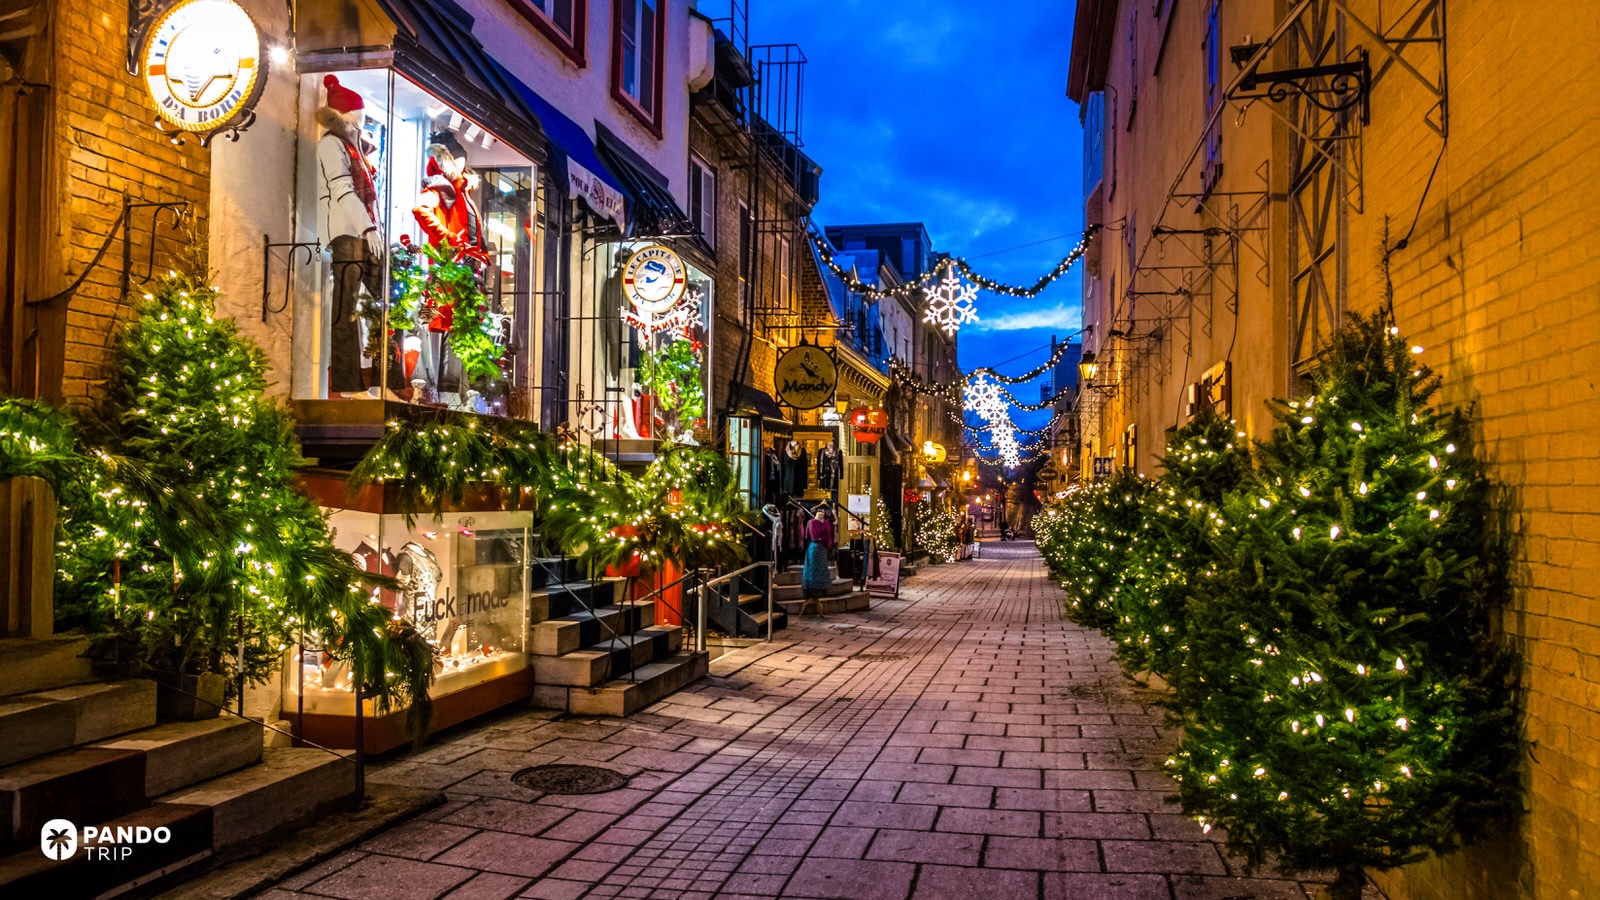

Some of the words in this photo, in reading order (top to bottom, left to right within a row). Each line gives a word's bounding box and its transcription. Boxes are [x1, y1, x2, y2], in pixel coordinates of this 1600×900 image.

[197, 89, 242, 123] BORD
[570, 173, 589, 194] POLO
[627, 262, 637, 275] LE
[626, 315, 647, 333] POUR
[781, 377, 833, 394] Mandy
[413, 586, 456, 625] Fuck
